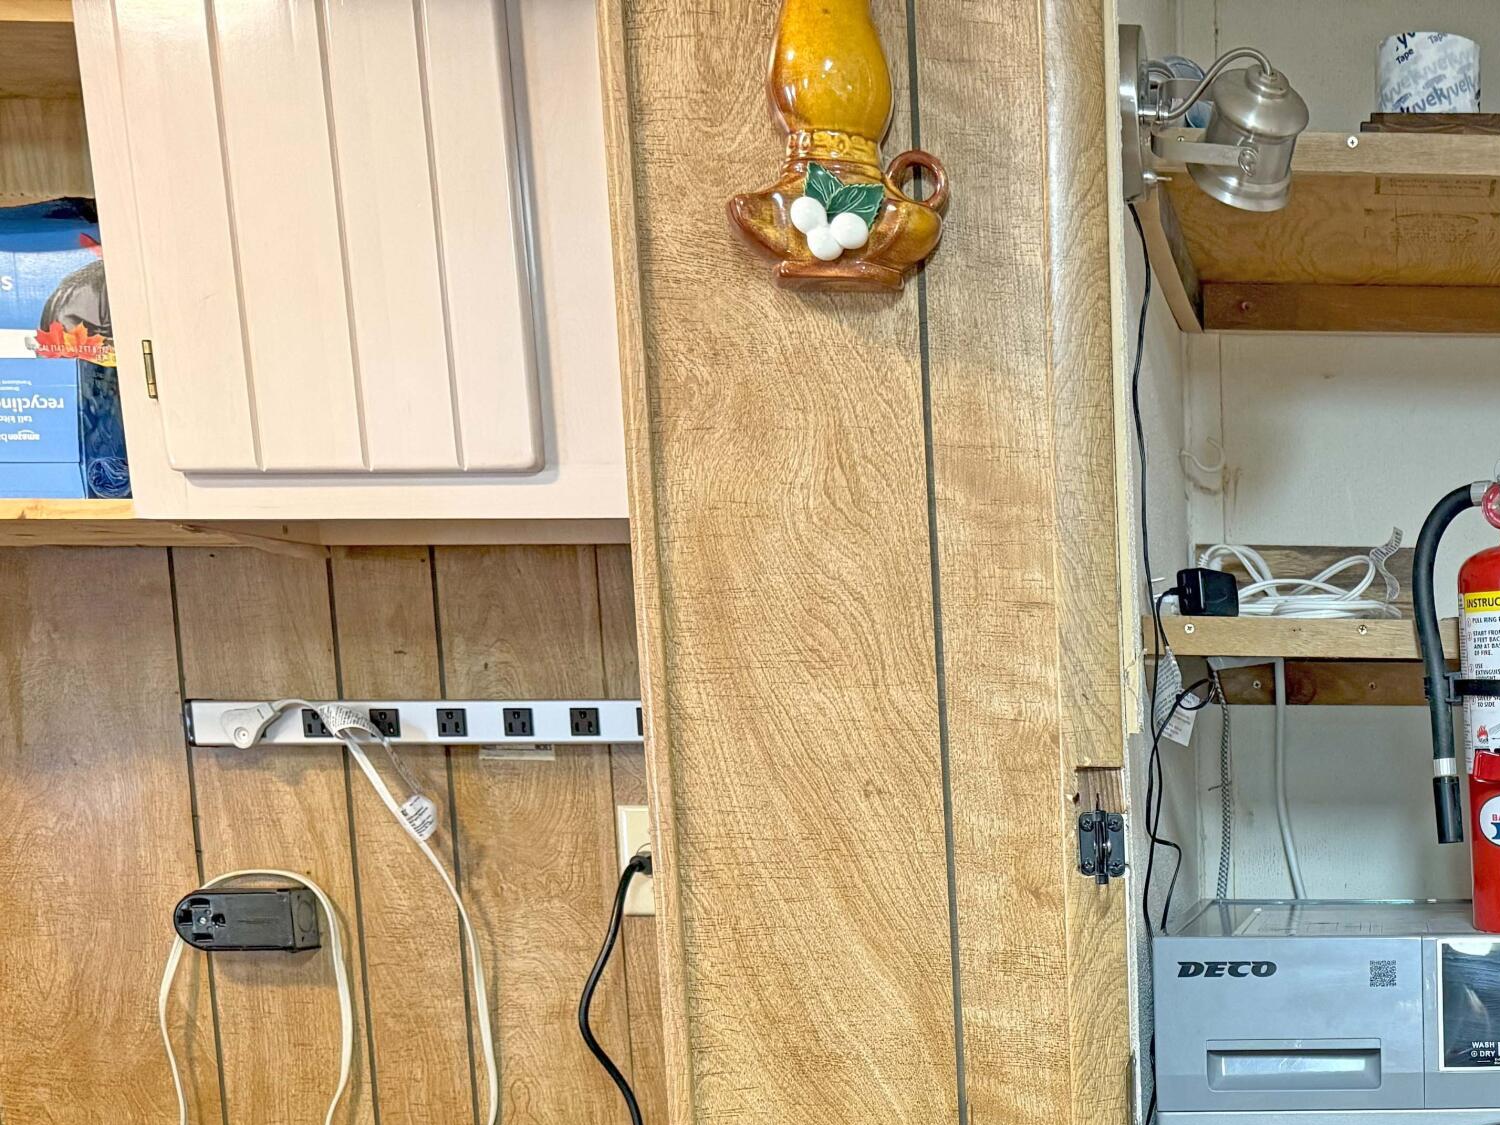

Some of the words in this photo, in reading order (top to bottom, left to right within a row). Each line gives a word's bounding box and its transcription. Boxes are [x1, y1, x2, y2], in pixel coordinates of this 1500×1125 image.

[1396, 48, 1414, 64] Tape
[0, 393, 64, 413] recyclin
[1177, 961, 1278, 978] DECO
[1472, 1041, 1495, 1049] WASH
